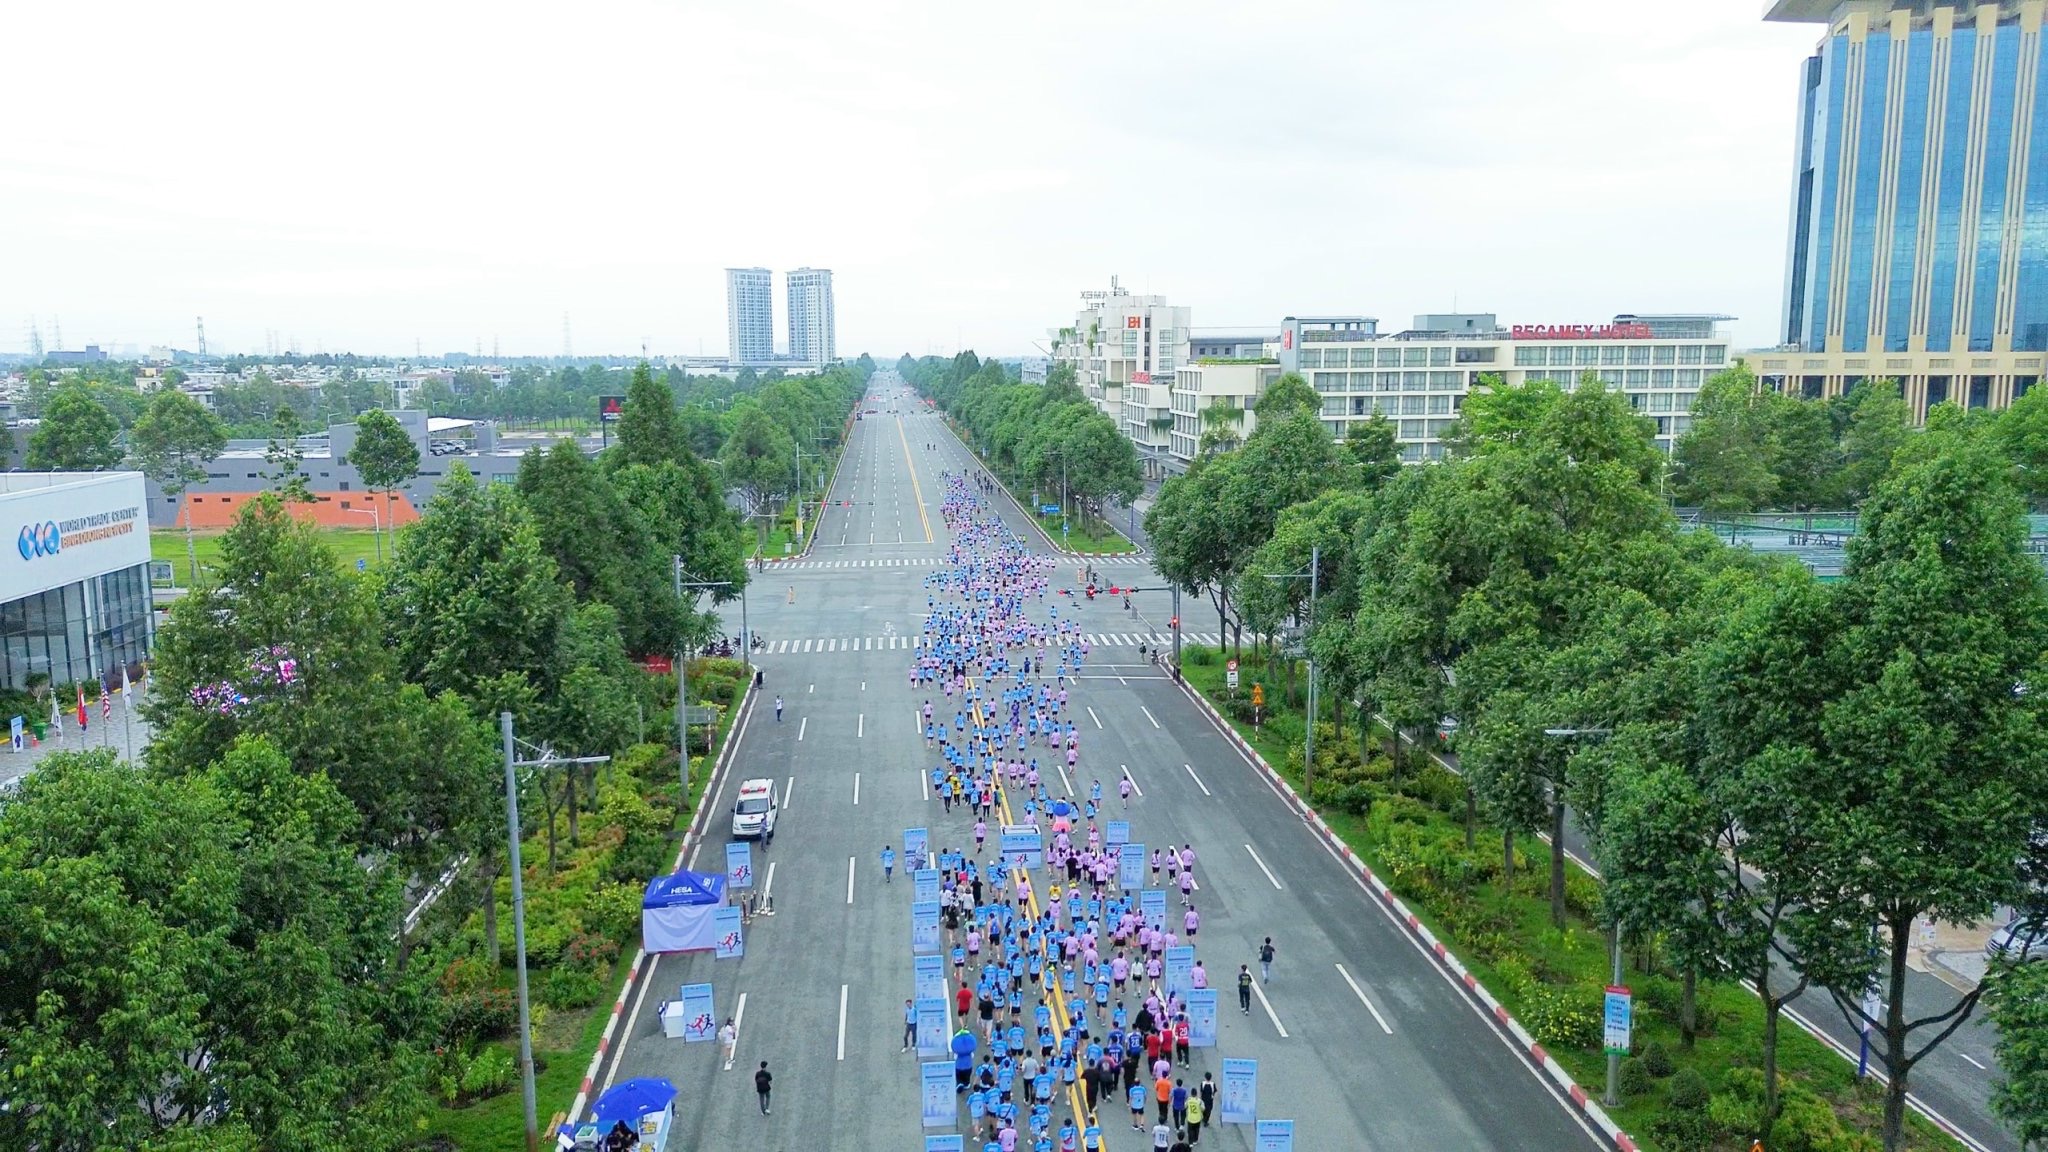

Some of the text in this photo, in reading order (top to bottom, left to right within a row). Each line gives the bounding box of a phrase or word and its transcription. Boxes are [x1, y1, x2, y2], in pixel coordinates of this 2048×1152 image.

[1512, 324, 1652, 340] BECAMEX HOTEL
[59, 506, 139, 534] WORLD TRADE CENTER
[671, 886, 693, 895] HESA
